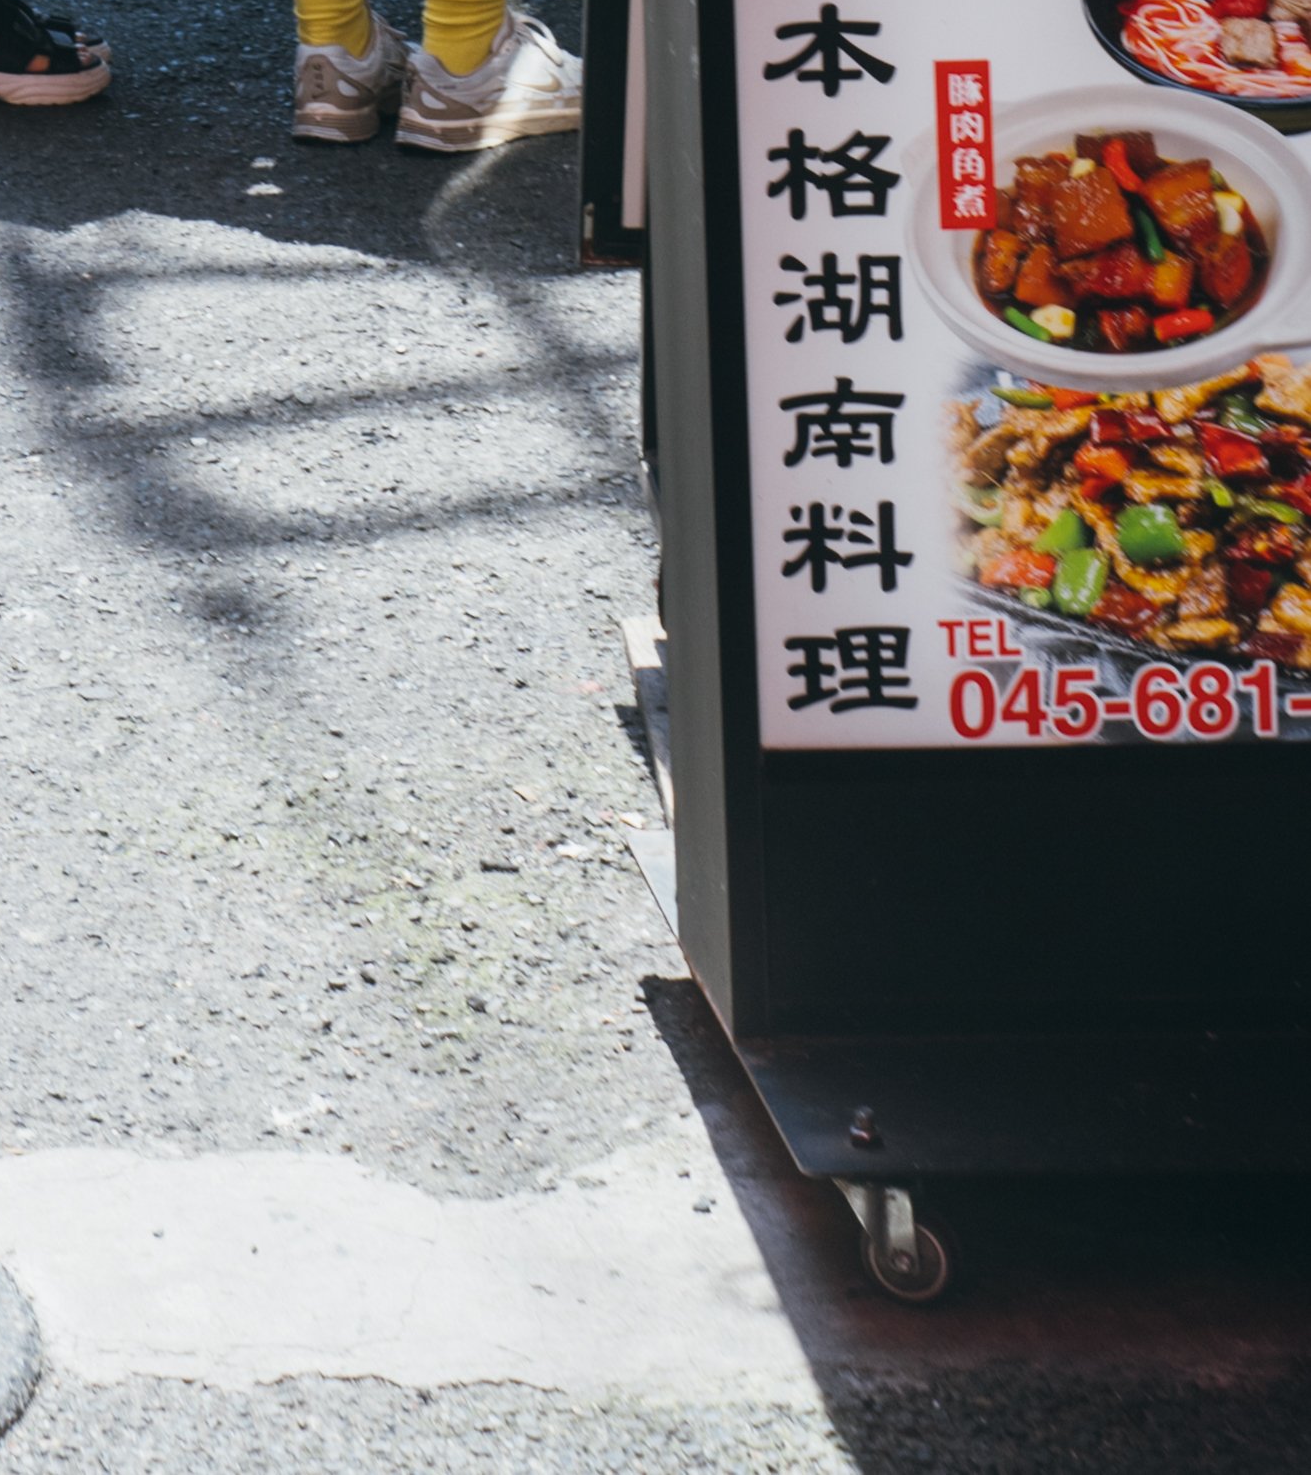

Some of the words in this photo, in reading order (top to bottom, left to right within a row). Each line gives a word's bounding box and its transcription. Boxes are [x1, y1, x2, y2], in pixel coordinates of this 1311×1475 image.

[947, 70, 990, 220] 豚肉角煮
[763, 2, 919, 715] 本格湖南料理
[937, 618, 1023, 661] TEL
[947, 661, 1311, 742] 045-681-
